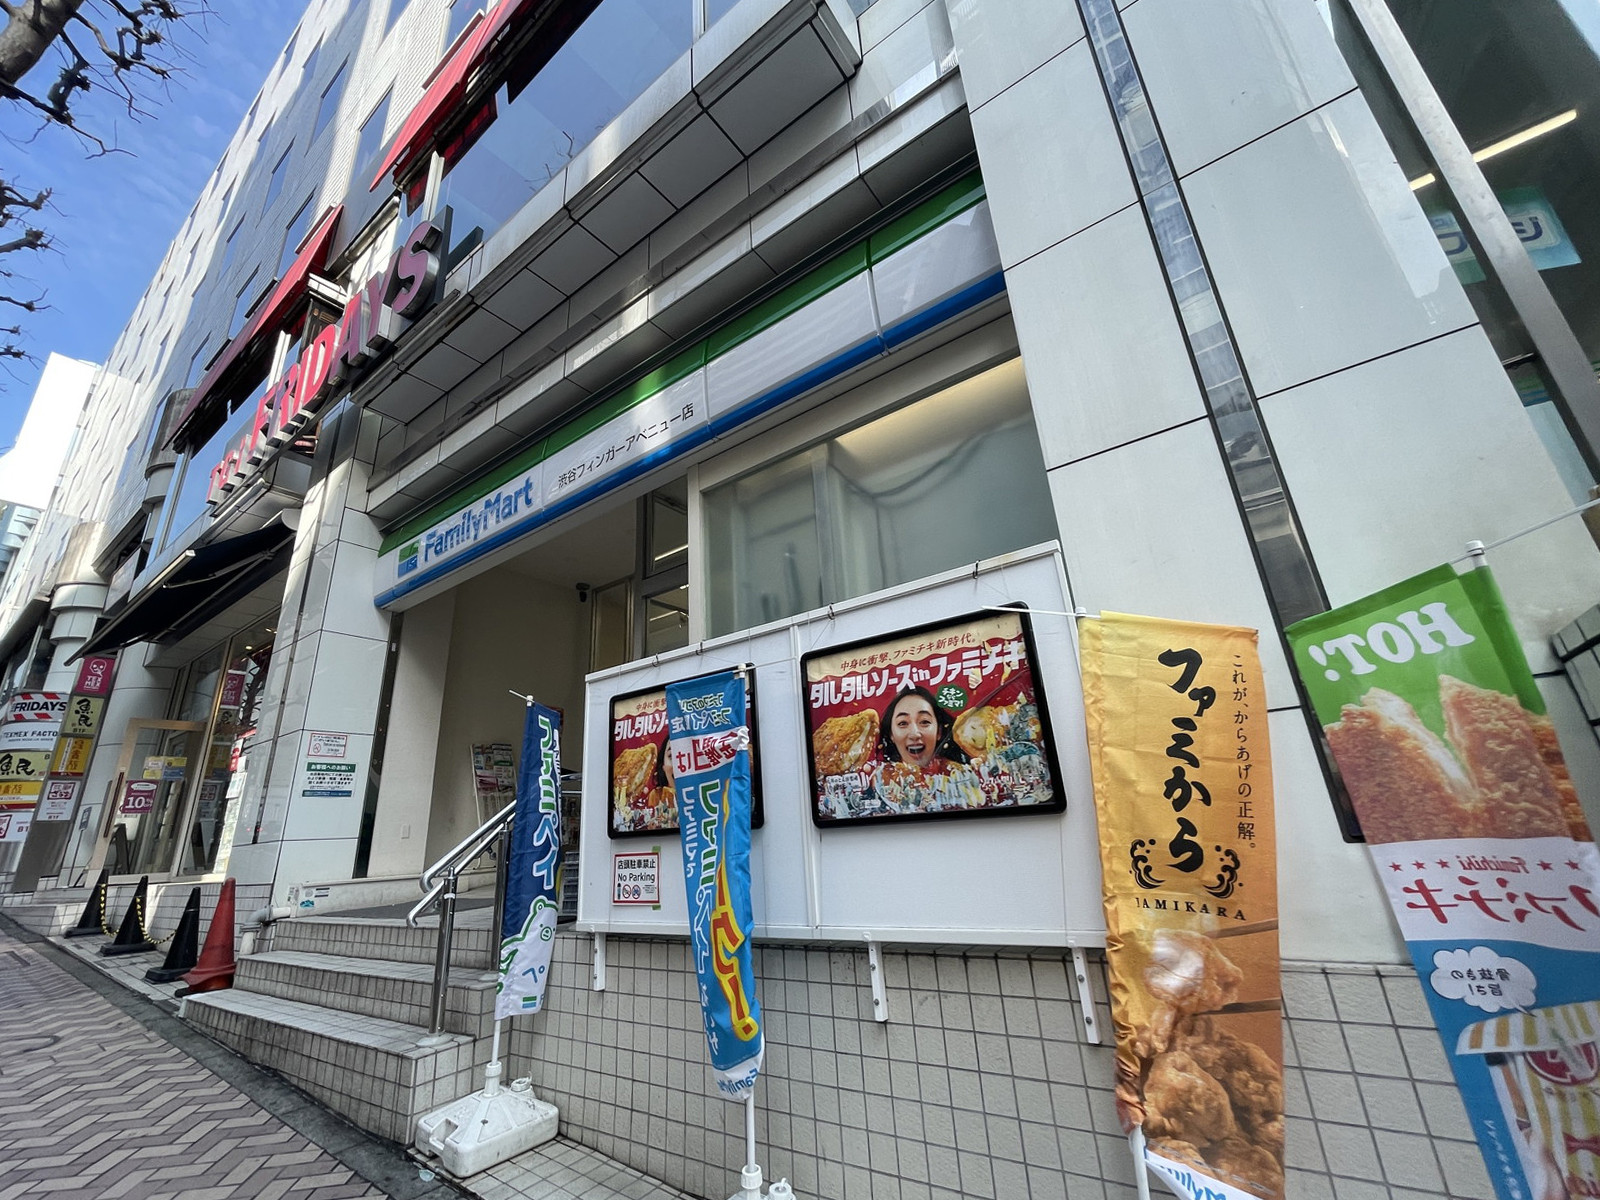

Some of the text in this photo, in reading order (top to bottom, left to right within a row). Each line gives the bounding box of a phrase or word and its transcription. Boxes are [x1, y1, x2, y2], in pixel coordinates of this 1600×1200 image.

[557, 403, 694, 488] 渋谷フィンガーアベニュー店
[424, 476, 534, 562] FamilyMart
[840, 633, 976, 672] 中身に衝撃、ファミチキ新時代。
[74, 698, 94, 727] 魚民
[1231, 654, 1257, 849] これが、からあげの正解。
[1157, 648, 1217, 873] ファミから
[617, 872, 656, 883] No Parking
